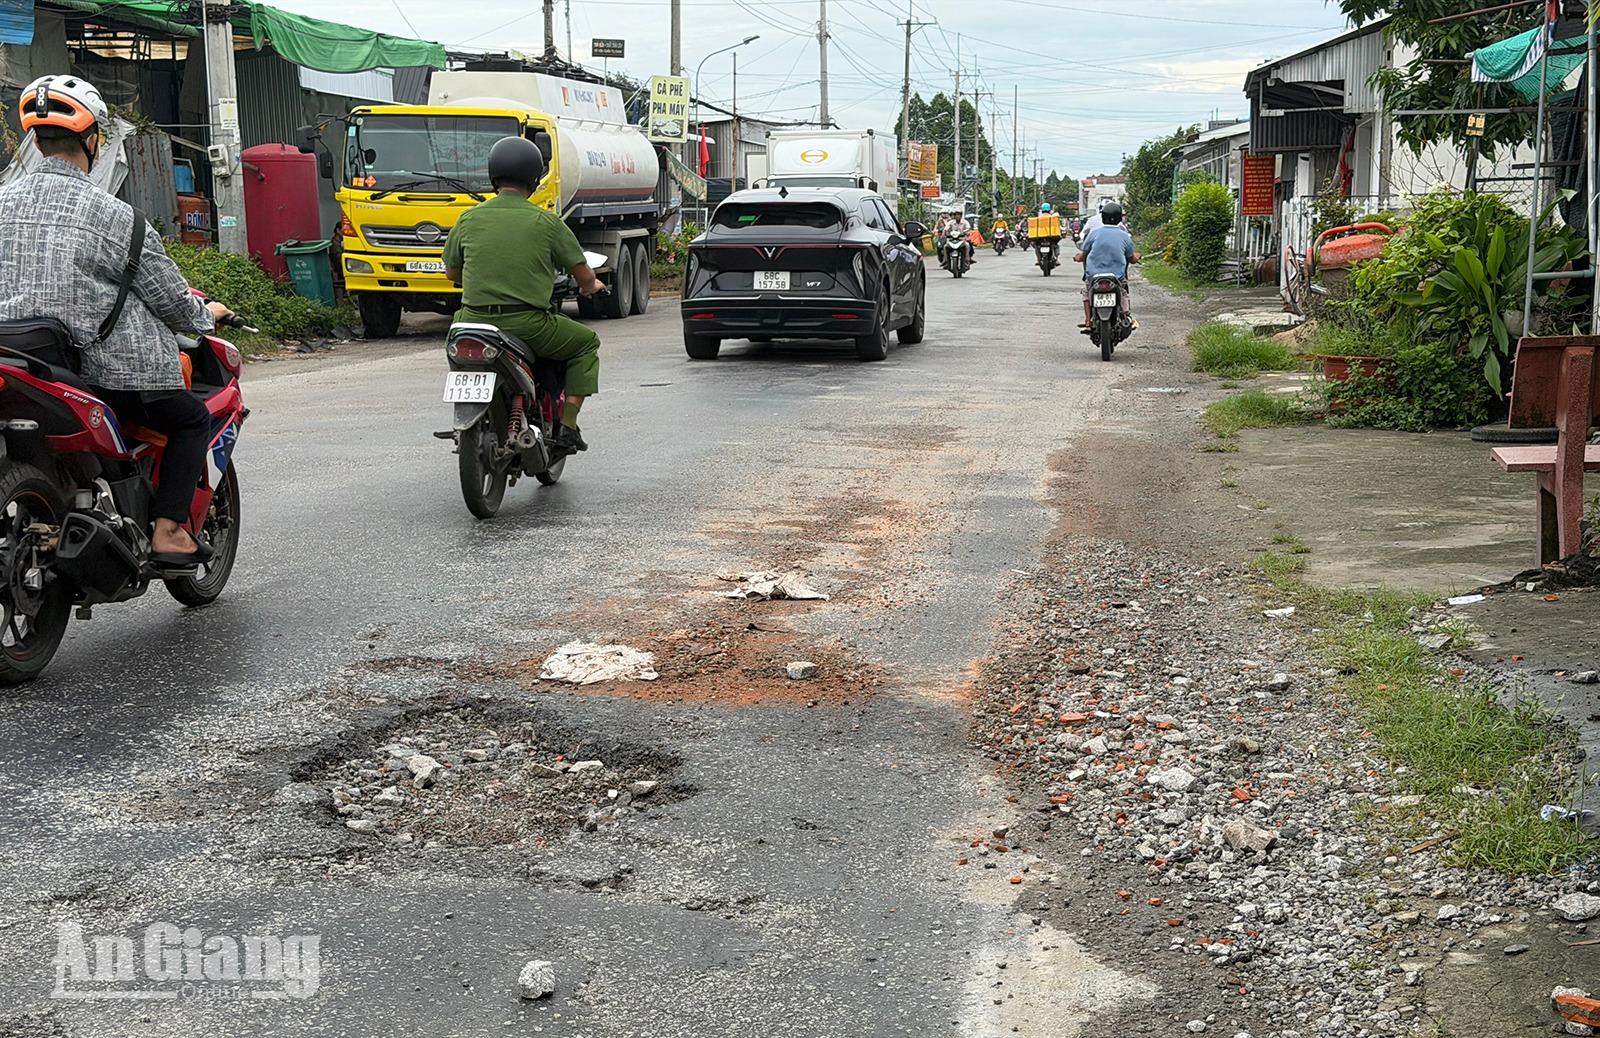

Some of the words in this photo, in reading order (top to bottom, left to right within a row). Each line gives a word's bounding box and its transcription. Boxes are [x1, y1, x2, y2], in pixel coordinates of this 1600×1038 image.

[657, 80, 668, 95] CÀ
[669, 82, 683, 97] PHÊ
[652, 101, 667, 115] PHA
[669, 101, 686, 116] MÁY
[455, 374, 487, 386] 68-D1
[449, 387, 490, 400] 115.33
